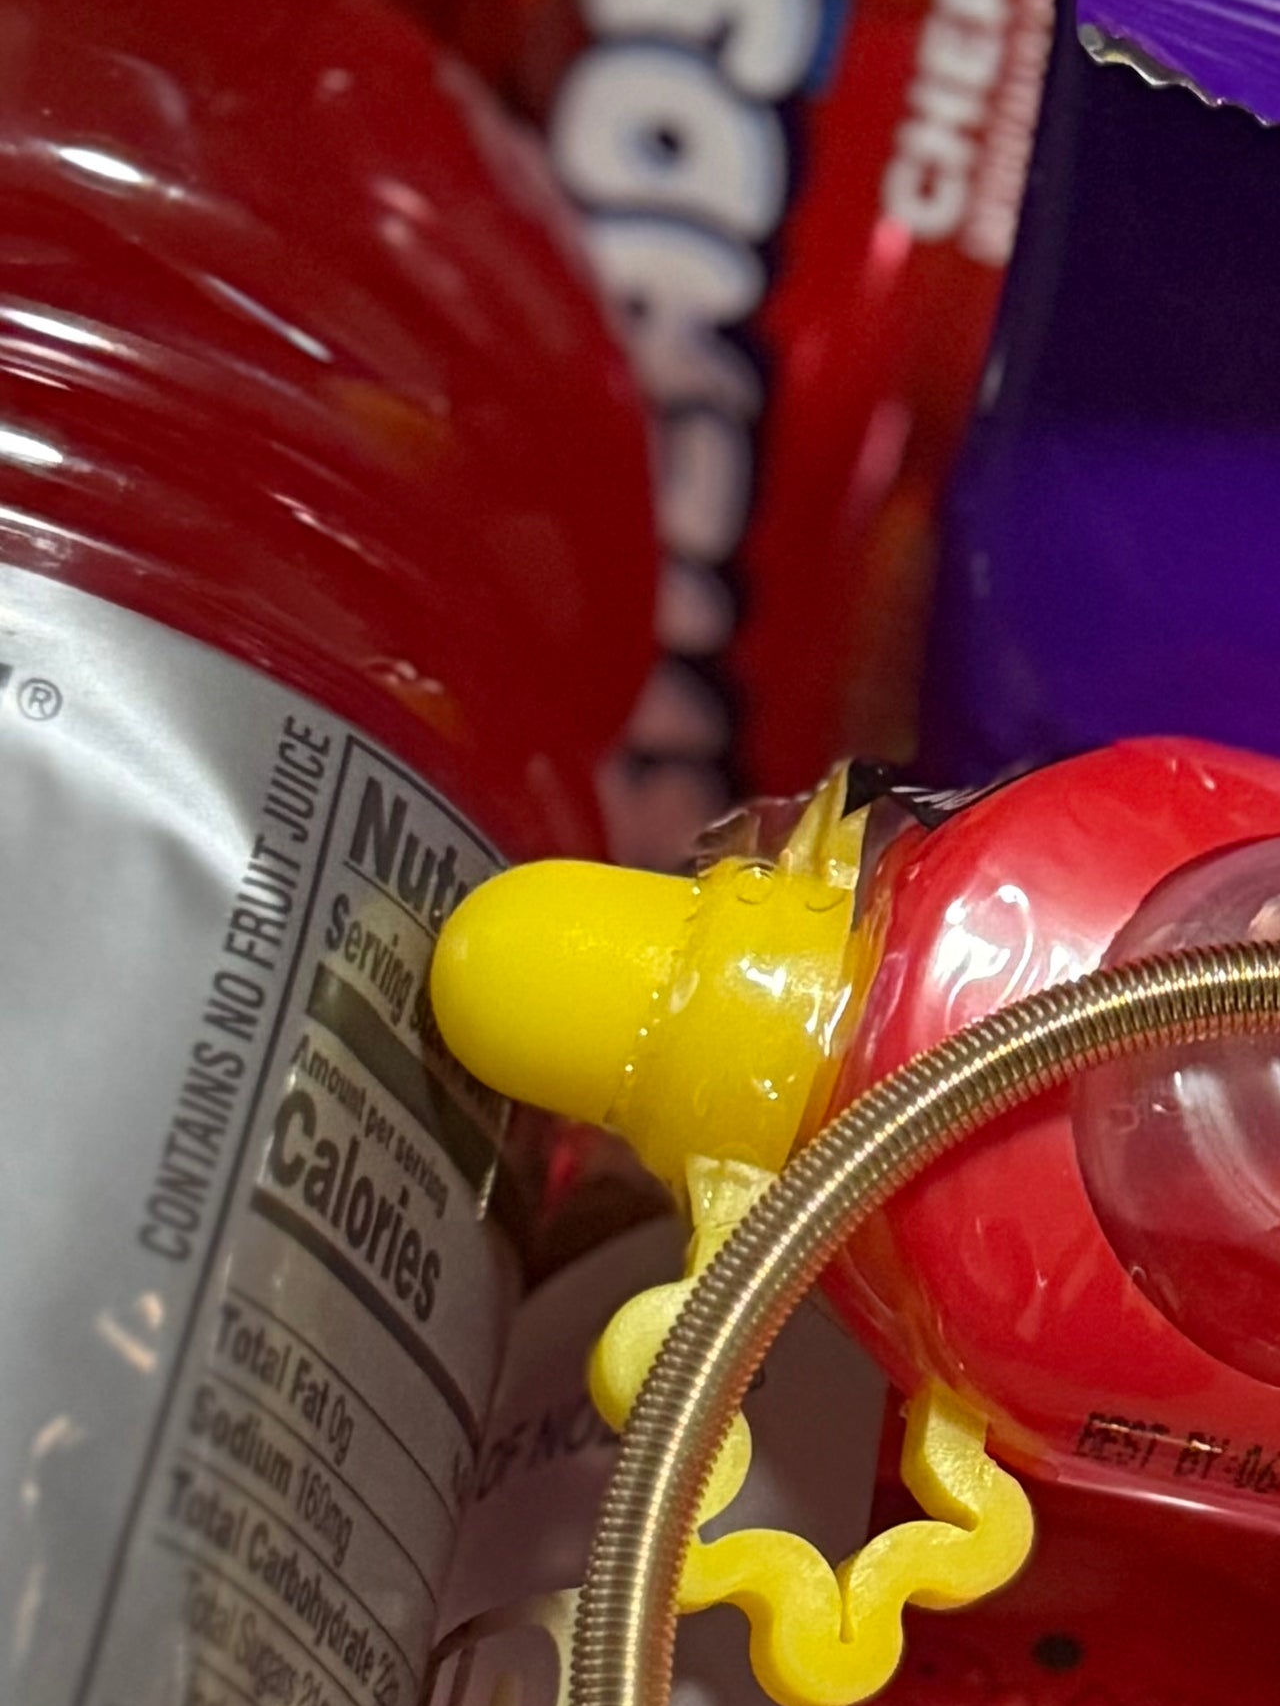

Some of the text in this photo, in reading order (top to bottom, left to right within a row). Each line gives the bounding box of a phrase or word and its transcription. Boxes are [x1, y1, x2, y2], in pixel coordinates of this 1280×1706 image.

[138, 715, 333, 1265] CONTAINS NO FRUIT JUICE
[325, 893, 415, 1028] Serving
[270, 1089, 442, 1324] Calories
[289, 1036, 367, 1122] Amount
[365, 1106, 396, 1151] per
[395, 1135, 449, 1220] serving
[189, 1383, 293, 1497] Sodium
[214, 1301, 356, 1467] Total Fat 0g
[1072, 1411, 1171, 1471] BEST
[165, 1464, 250, 1556] Total
[247, 1520, 374, 1688] Carbohydrate
